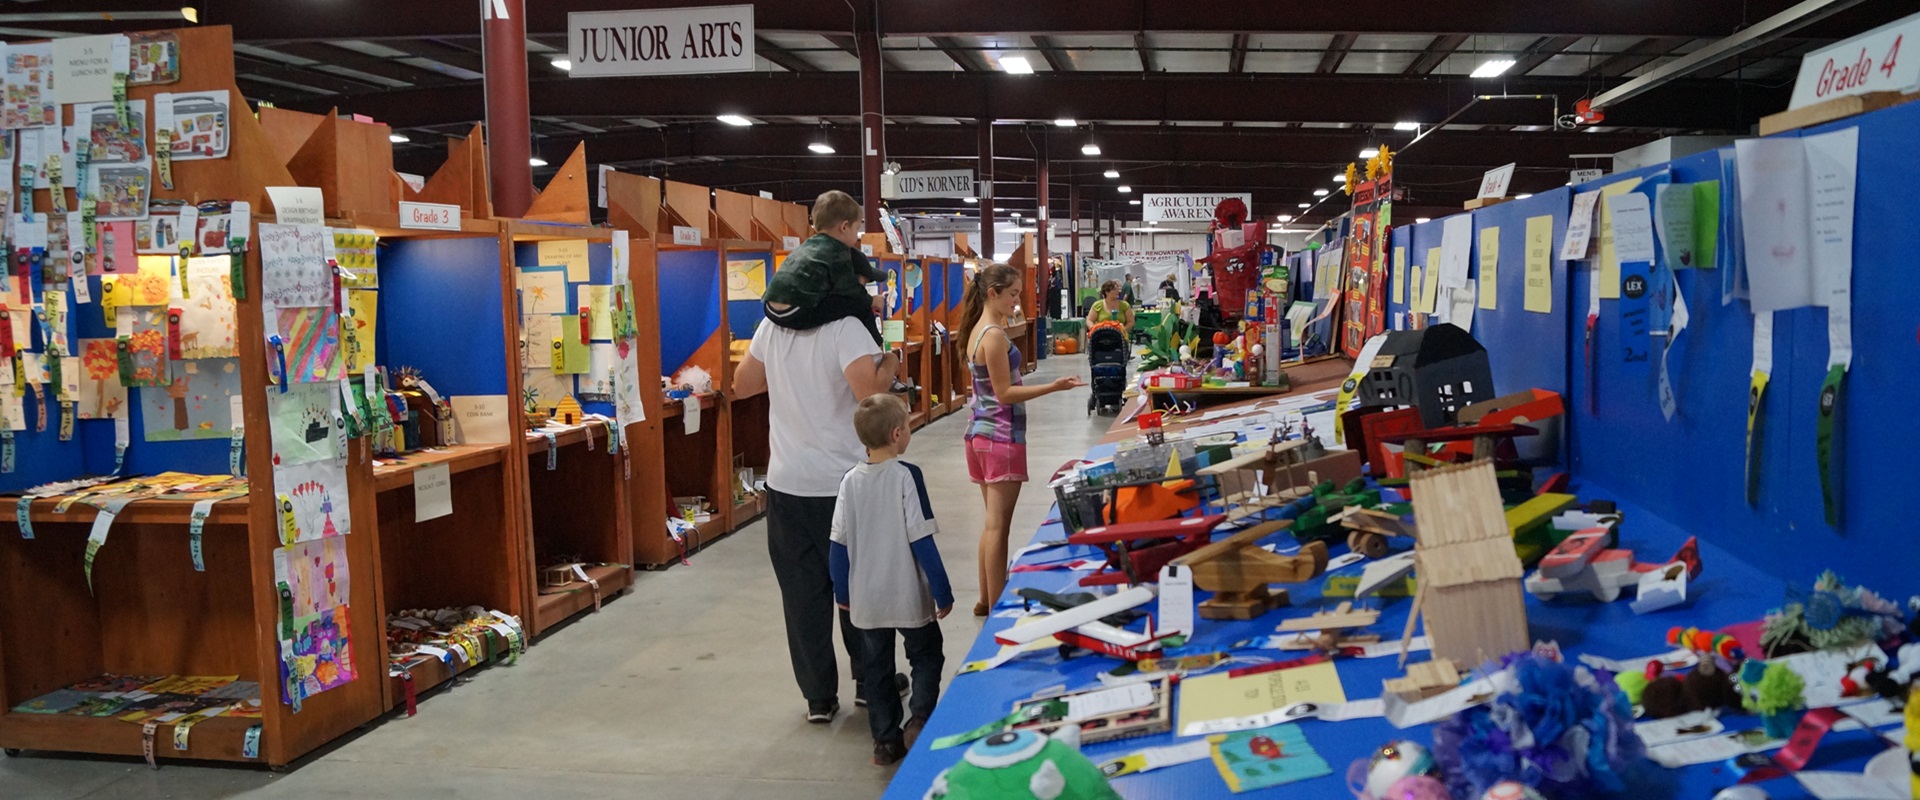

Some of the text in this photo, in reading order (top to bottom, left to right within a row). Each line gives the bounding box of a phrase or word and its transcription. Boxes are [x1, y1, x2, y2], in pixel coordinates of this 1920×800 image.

[579, 21, 743, 63] JUNIOR ARTS
[71, 68, 107, 77] LUNCH BOX
[1816, 33, 1903, 98] Grade 4
[865, 127, 878, 155] L
[927, 175, 970, 192] KORNER
[981, 180, 992, 199] M
[1148, 196, 1242, 207] AGRICULTU
[413, 208, 449, 224] Grade 3
[1039, 206, 1046, 220] N
[1162, 208, 1217, 219] AWAREN
[1094, 231, 1100, 241] P
[1626, 281, 1642, 291] LEX
[1624, 346, 1648, 362] 2nd
